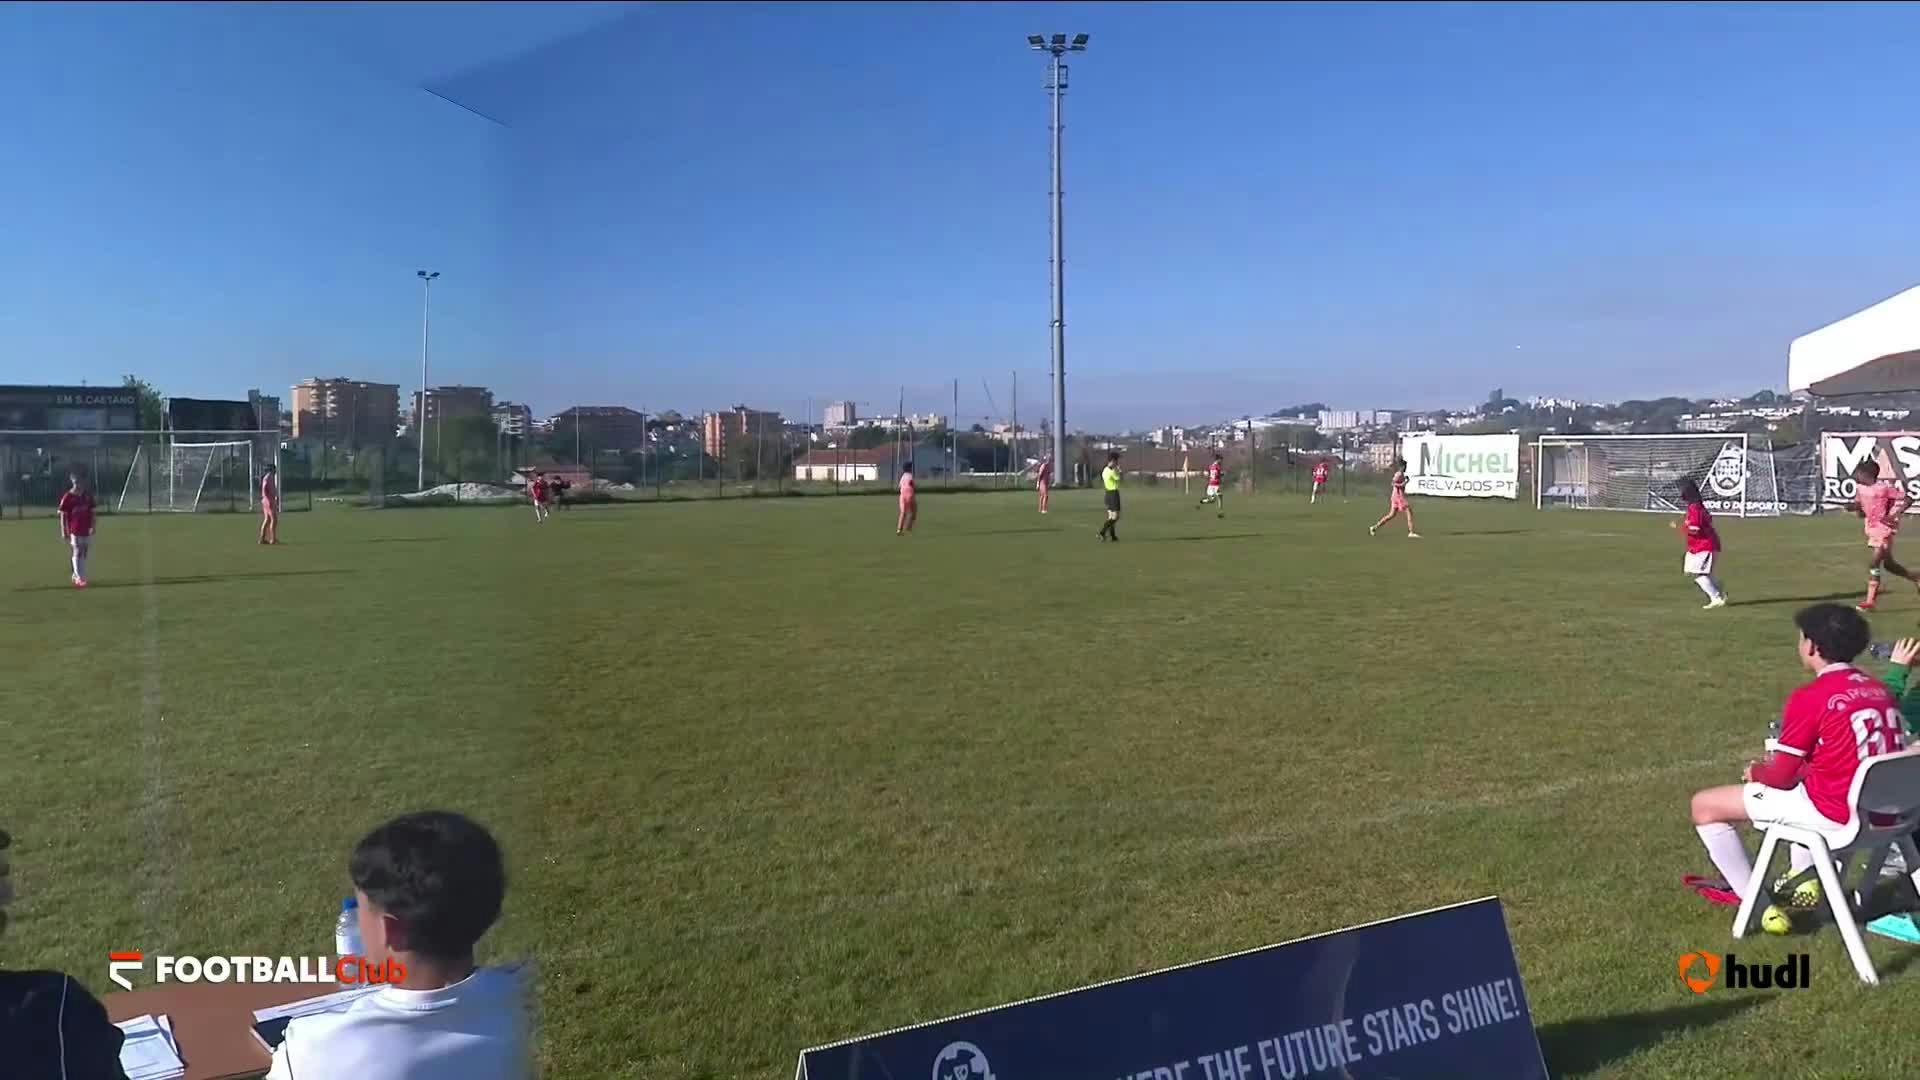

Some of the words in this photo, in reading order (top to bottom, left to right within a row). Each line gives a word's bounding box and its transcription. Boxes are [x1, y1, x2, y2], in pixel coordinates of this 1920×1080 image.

[1198, 1045, 1252, 1080] THE
[1258, 1019, 1362, 1080] FUTURE
[1363, 999, 1441, 1056] STARS
[1442, 977, 1521, 1034] SHINE!
